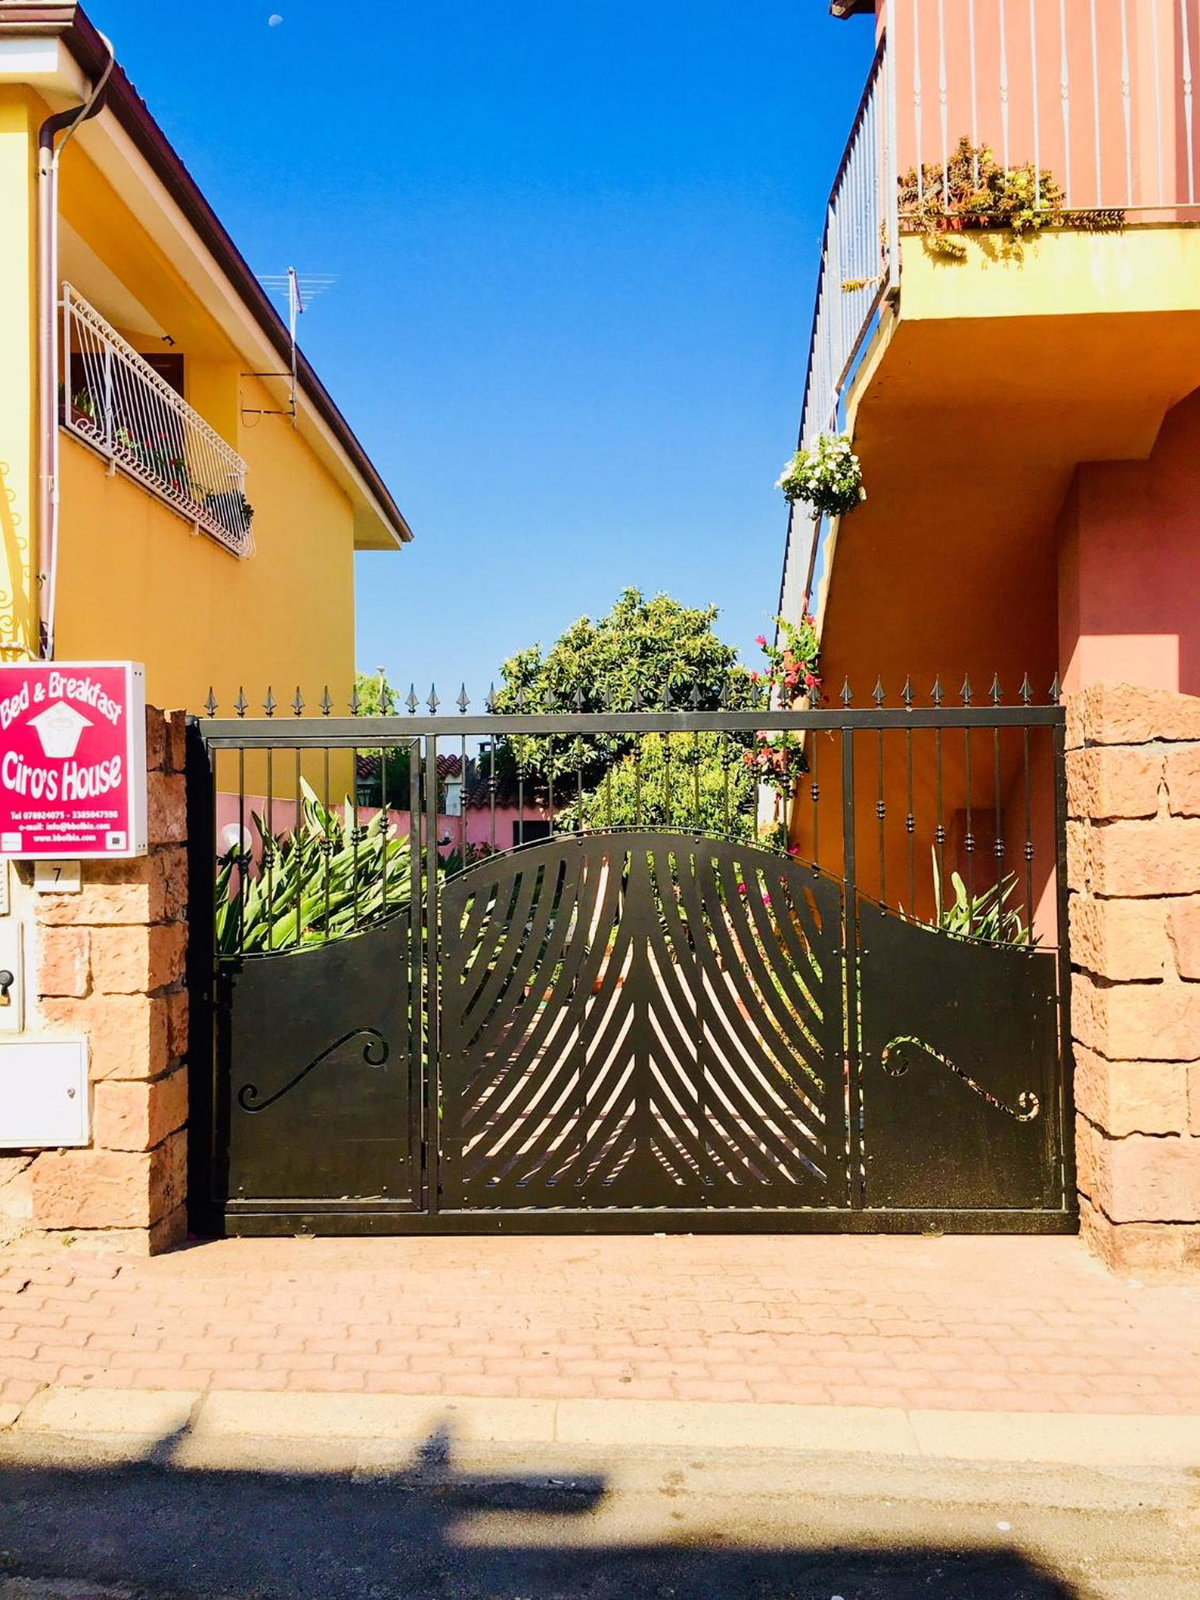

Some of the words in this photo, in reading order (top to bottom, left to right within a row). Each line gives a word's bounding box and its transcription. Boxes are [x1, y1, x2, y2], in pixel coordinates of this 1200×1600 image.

[0, 682, 29, 730] Bed
[33, 682, 46, 703] &
[48, 672, 123, 726] Breakfast
[2, 751, 58, 801] Ciro's
[61, 755, 122, 801] House
[10, 811, 22, 820] Tel
[53, 868, 62, 883] 7
